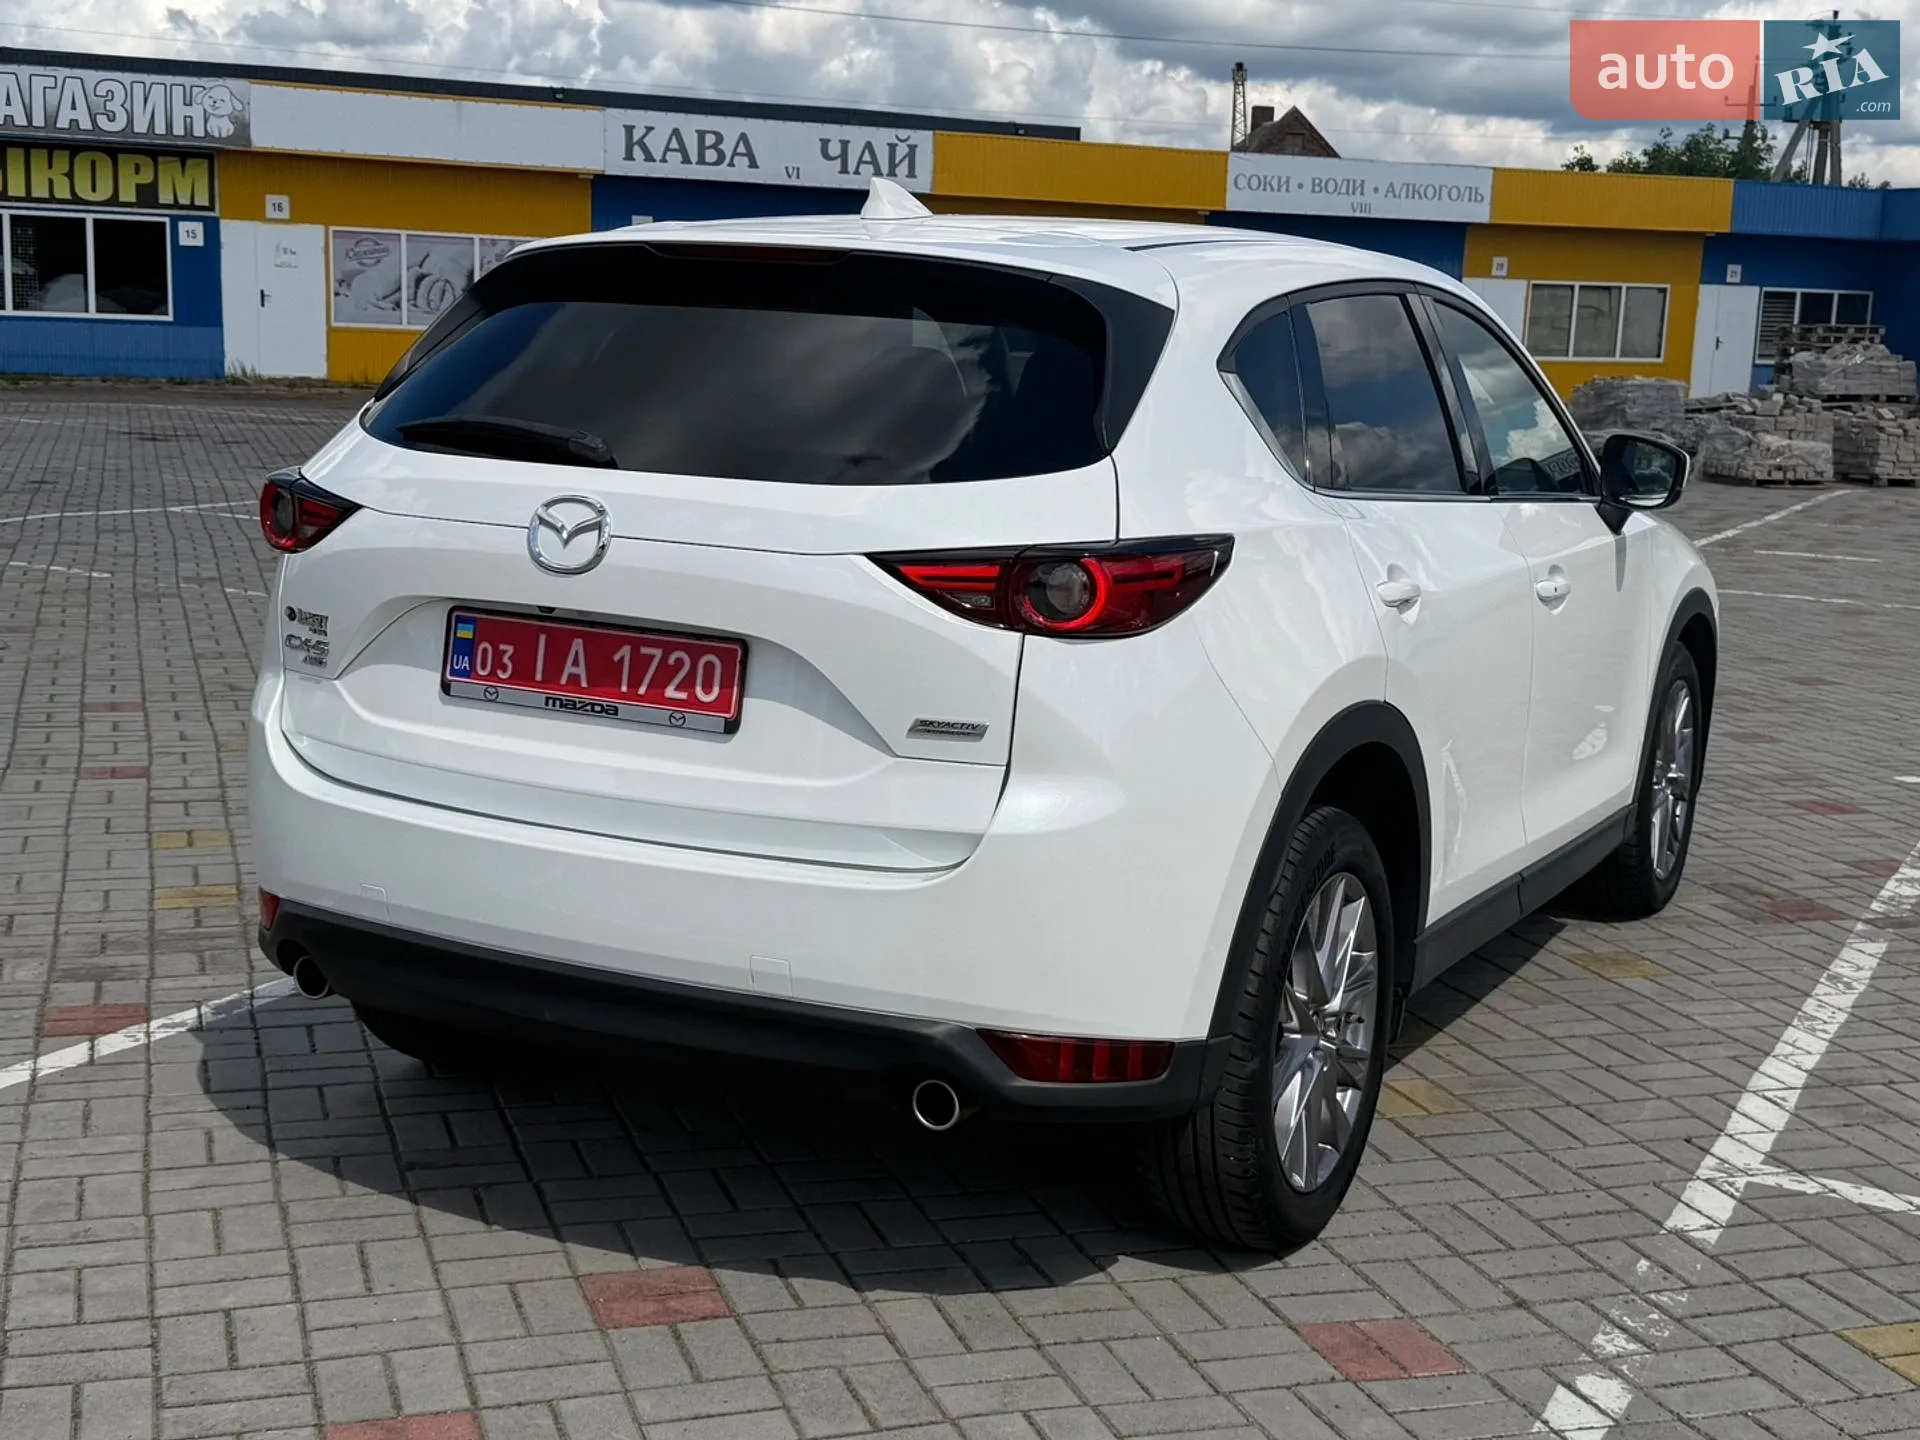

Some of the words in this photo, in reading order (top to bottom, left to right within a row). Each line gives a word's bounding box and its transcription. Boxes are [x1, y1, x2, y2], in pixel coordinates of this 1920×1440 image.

[622, 124, 760, 169] КАВА
[819, 134, 919, 179] ЧАЙ
[1233, 173, 1291, 193] СОКИ
[1310, 176, 1366, 198] ВОДИ
[1384, 182, 1485, 204] АЛКОГОЛЬ
[271, 201, 284, 213] 16
[184, 229, 198, 240] 15
[453, 655, 470, 671] UA
[475, 641, 515, 680] 03
[612, 644, 722, 704] 1720
[919, 719, 980, 731] SKYACTIV
